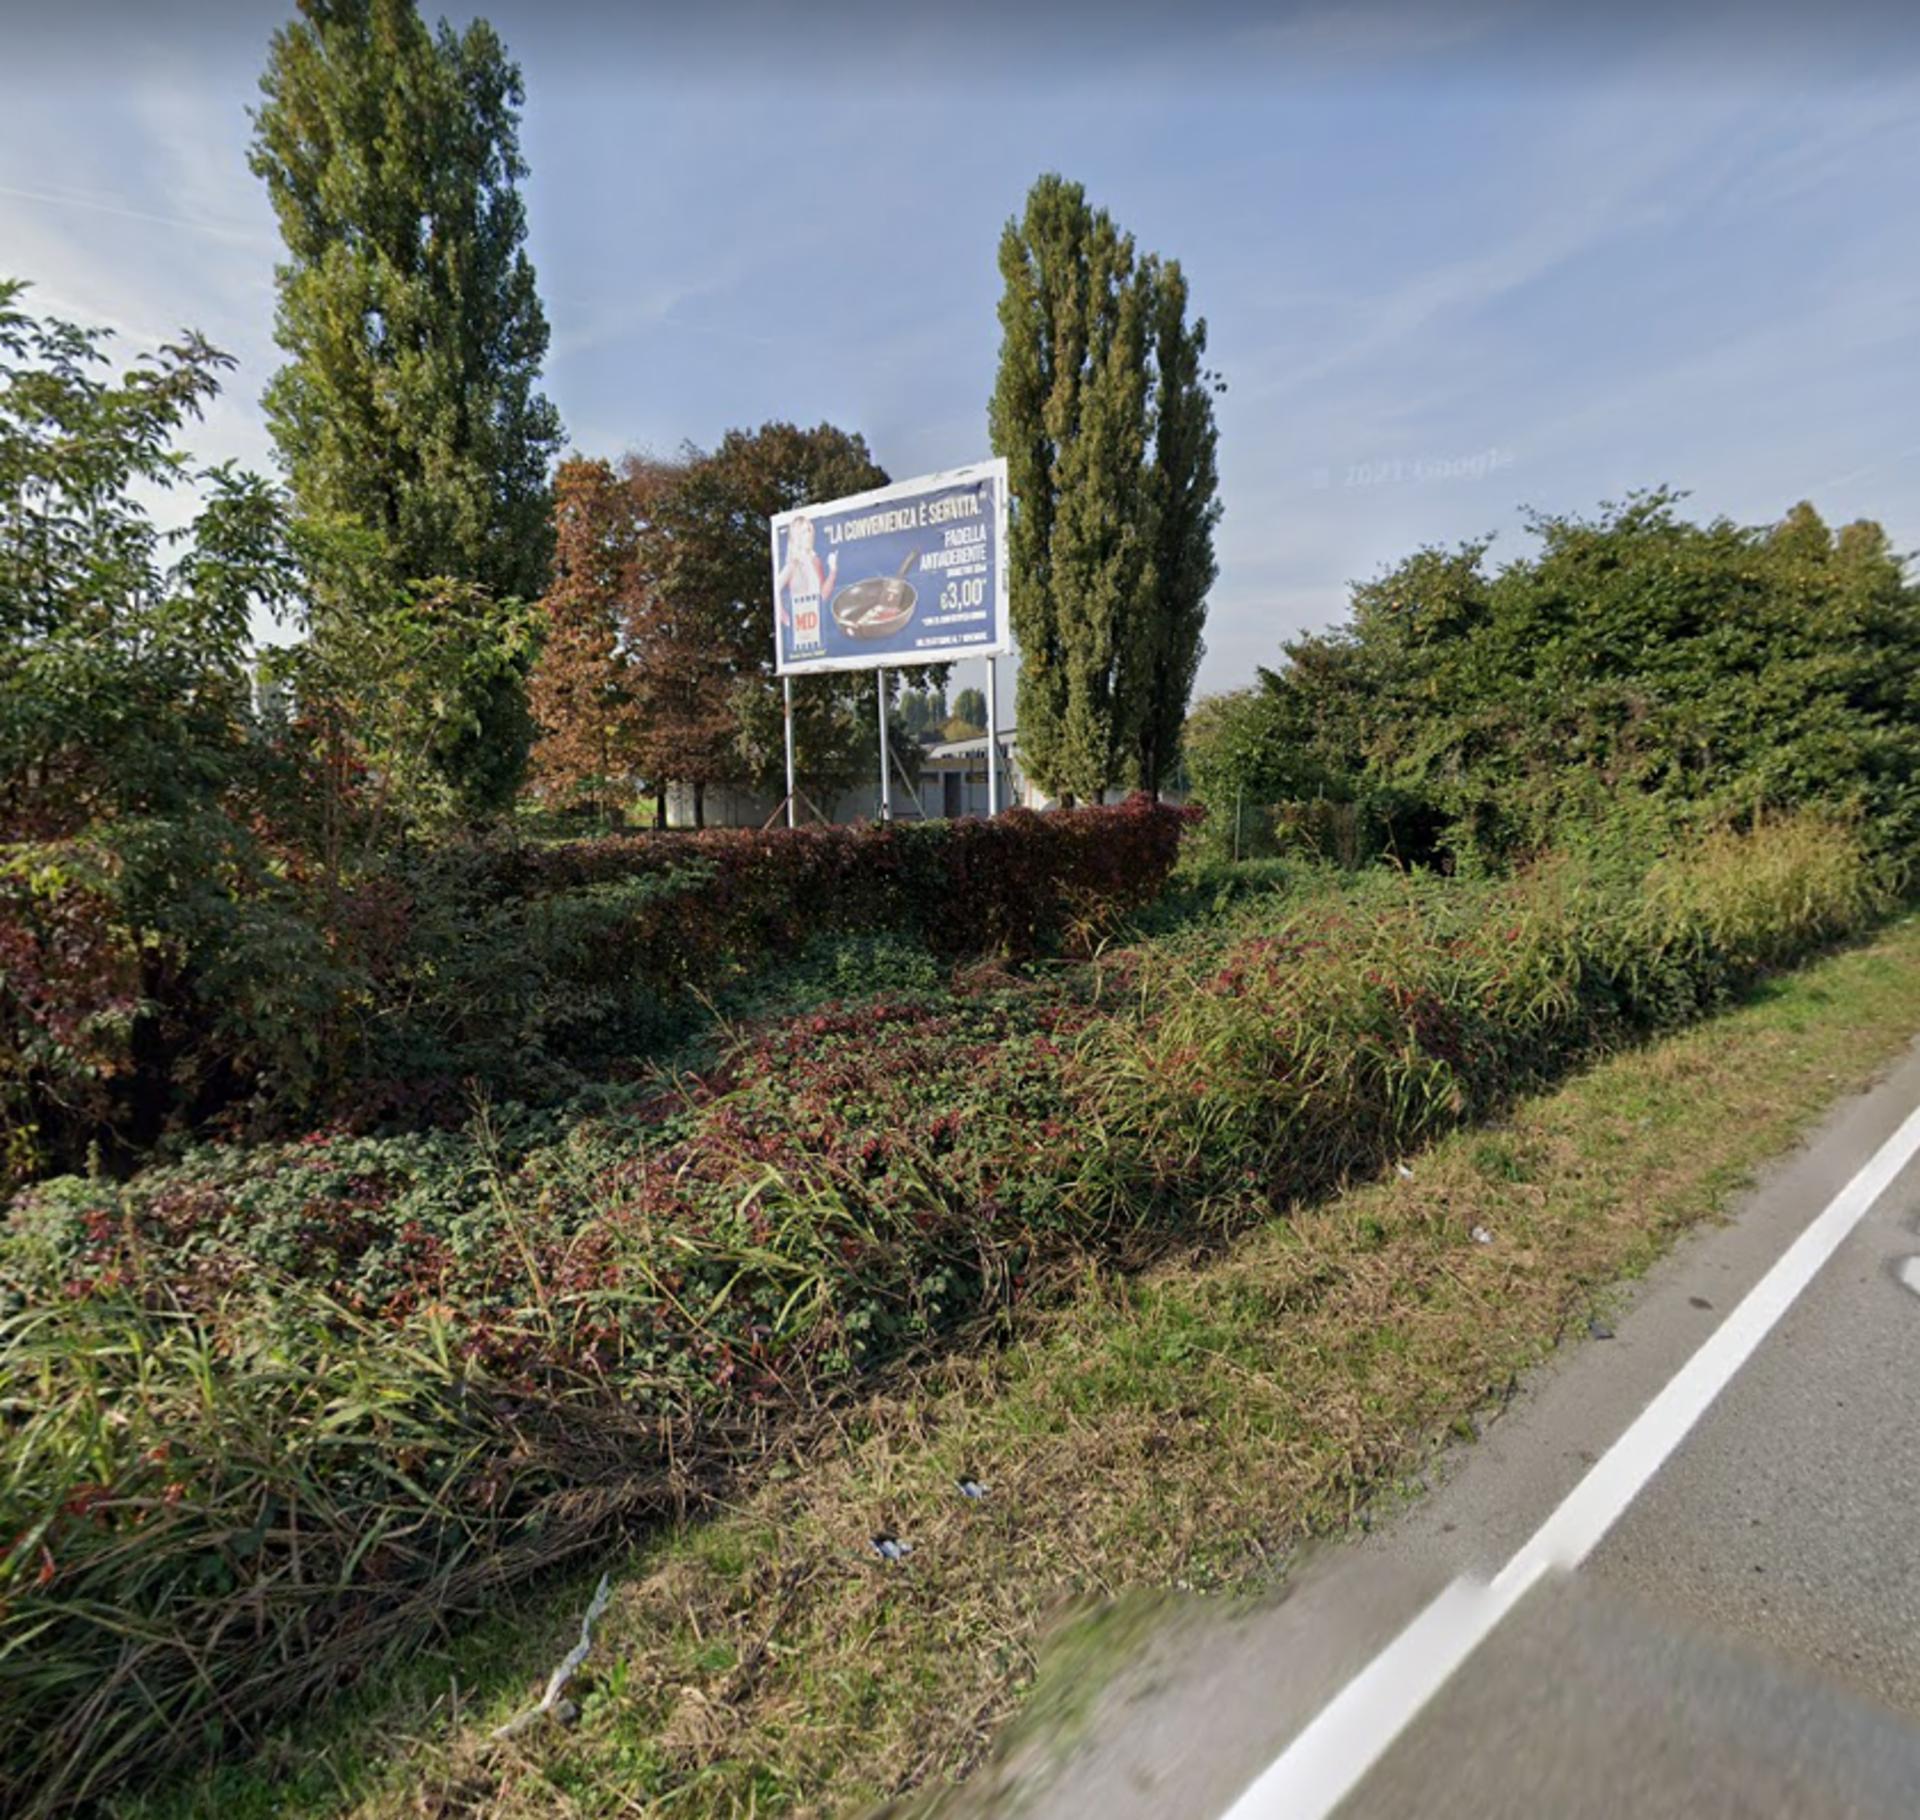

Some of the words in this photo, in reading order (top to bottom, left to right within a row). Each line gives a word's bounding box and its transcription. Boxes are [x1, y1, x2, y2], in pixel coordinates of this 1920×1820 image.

[845, 506, 917, 541] CONVENIENZA
[944, 524, 987, 548] PADELLA
[795, 612, 817, 630] MD
